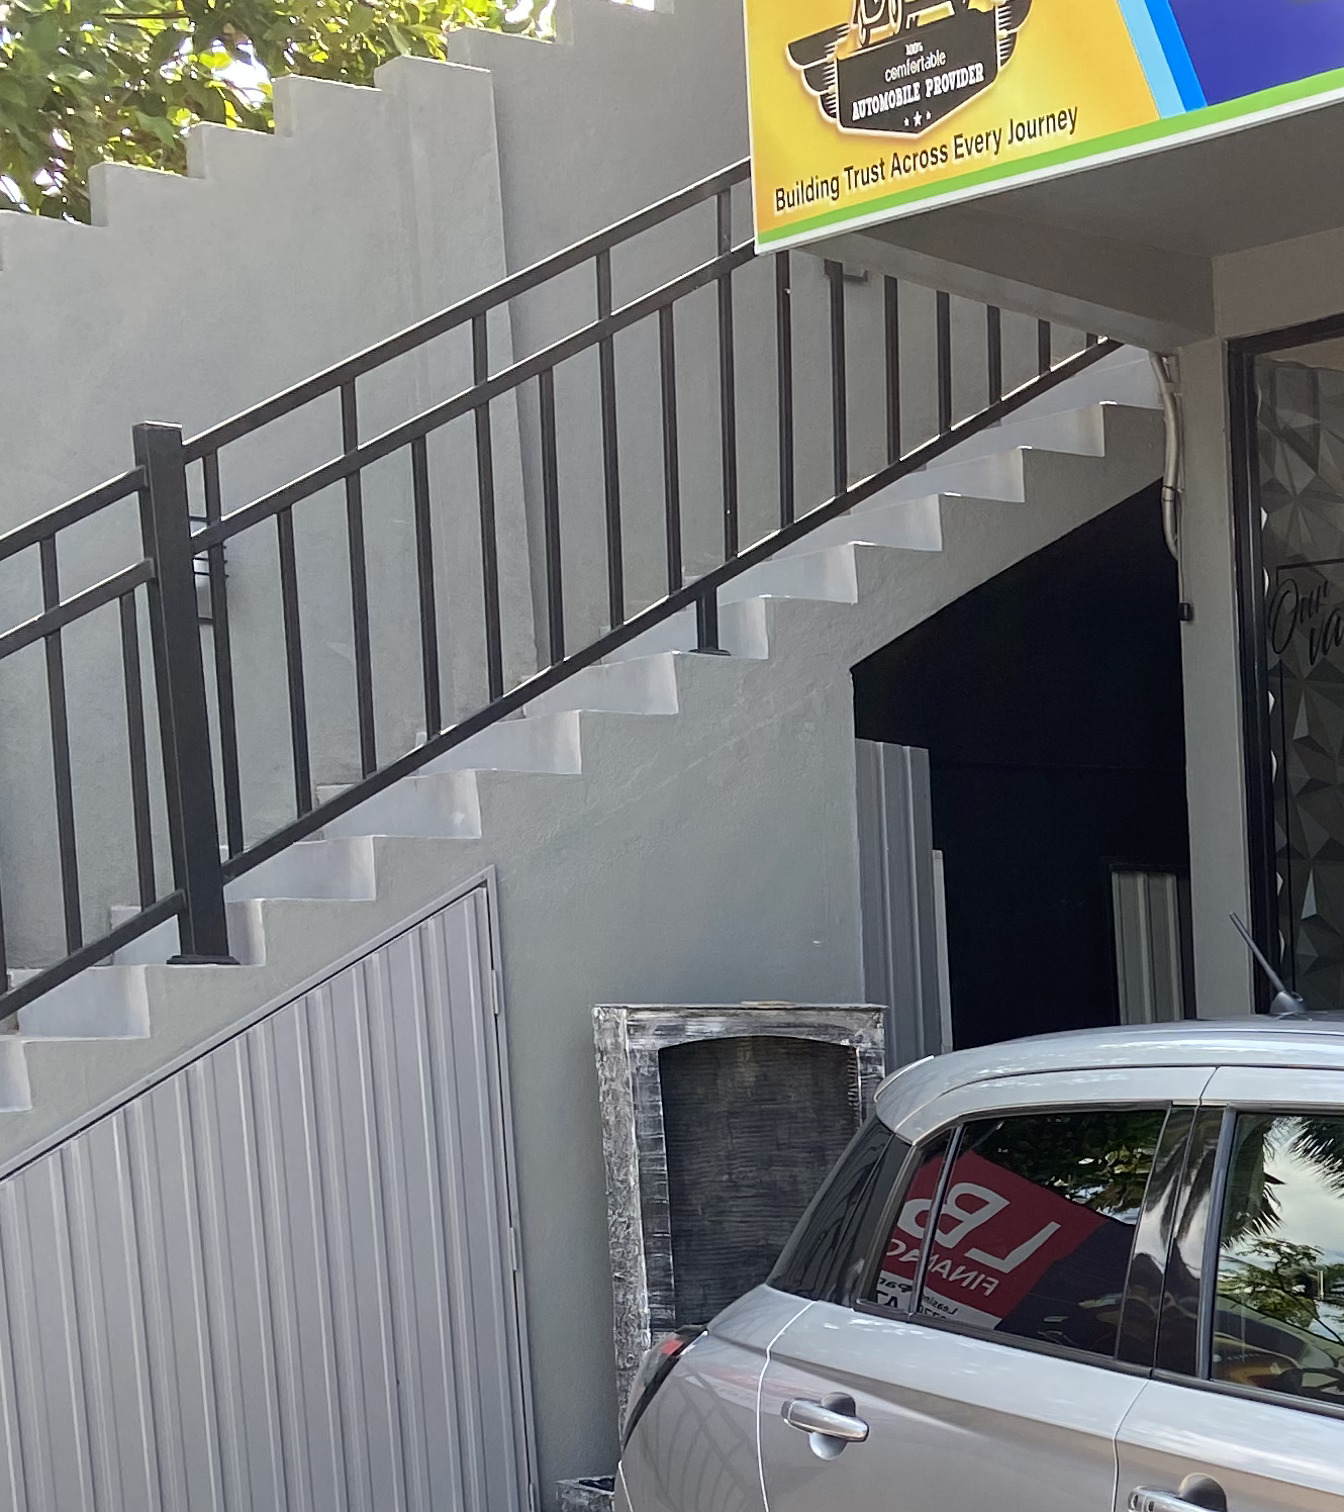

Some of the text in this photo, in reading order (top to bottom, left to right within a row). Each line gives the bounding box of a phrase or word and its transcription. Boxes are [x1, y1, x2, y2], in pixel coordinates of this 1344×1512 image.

[852, 62, 985, 121] AUTOMOBILE PROVIDER
[775, 106, 1078, 212] Building Trust Across Every Journey
[1268, 577, 1329, 655] Our
